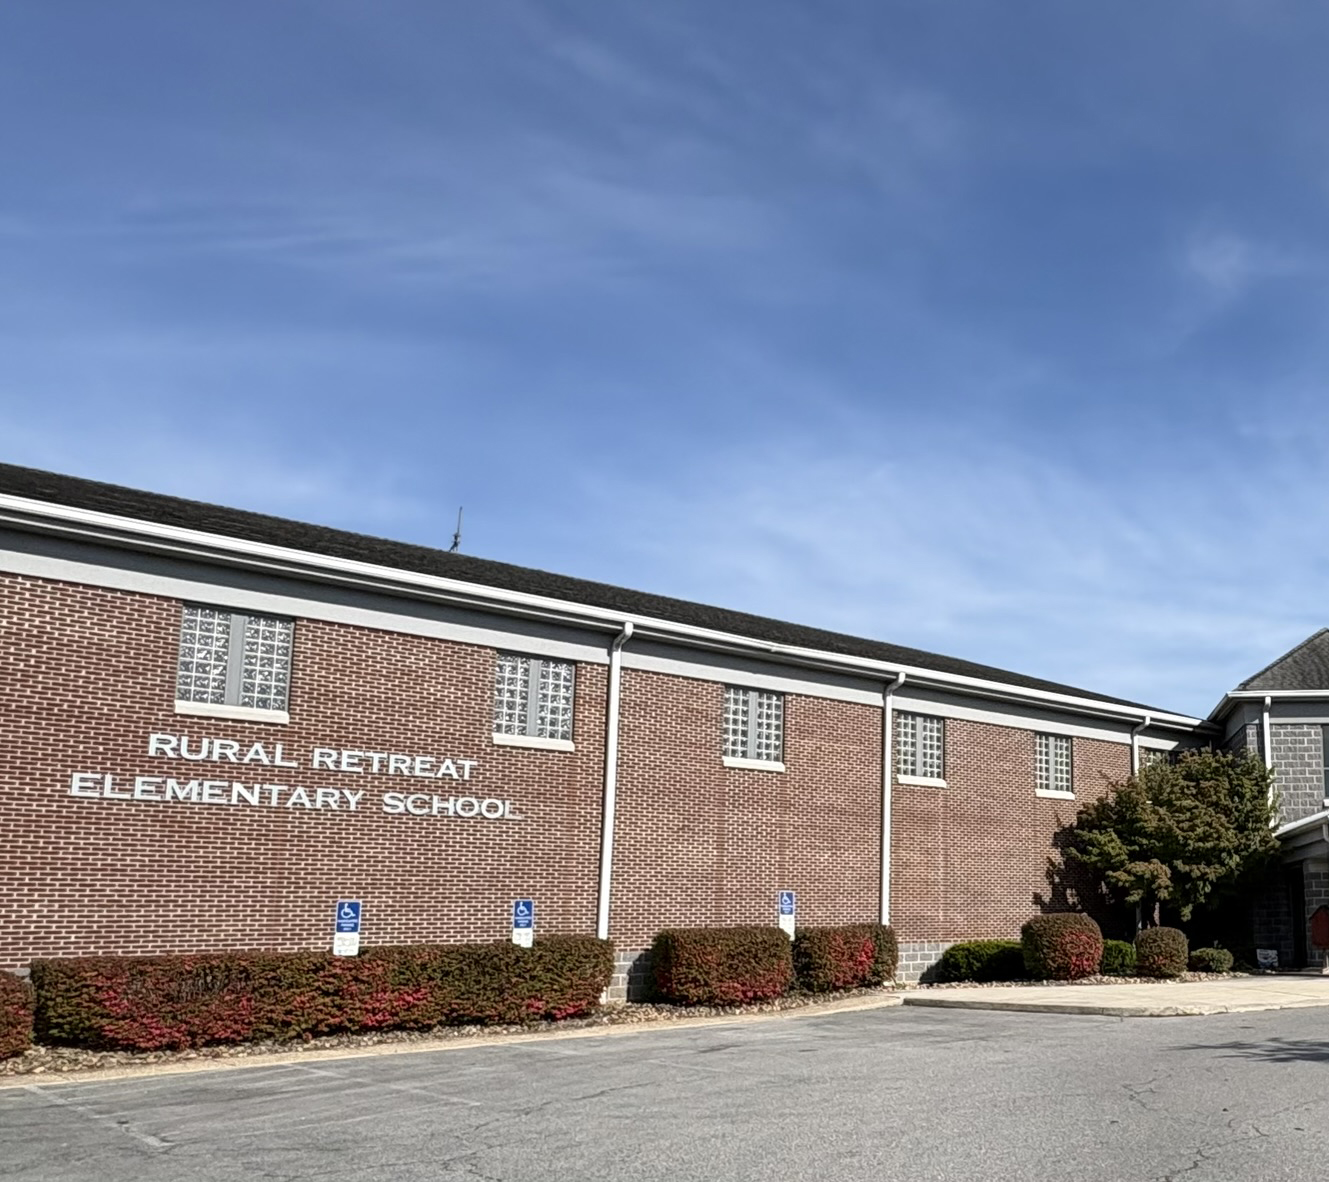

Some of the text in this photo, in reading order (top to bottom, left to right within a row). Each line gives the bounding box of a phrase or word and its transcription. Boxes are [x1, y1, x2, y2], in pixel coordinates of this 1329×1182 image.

[148, 734, 478, 780] RURAL RETREAT
[70, 773, 522, 819] ELEMENTARY SCHOOL
